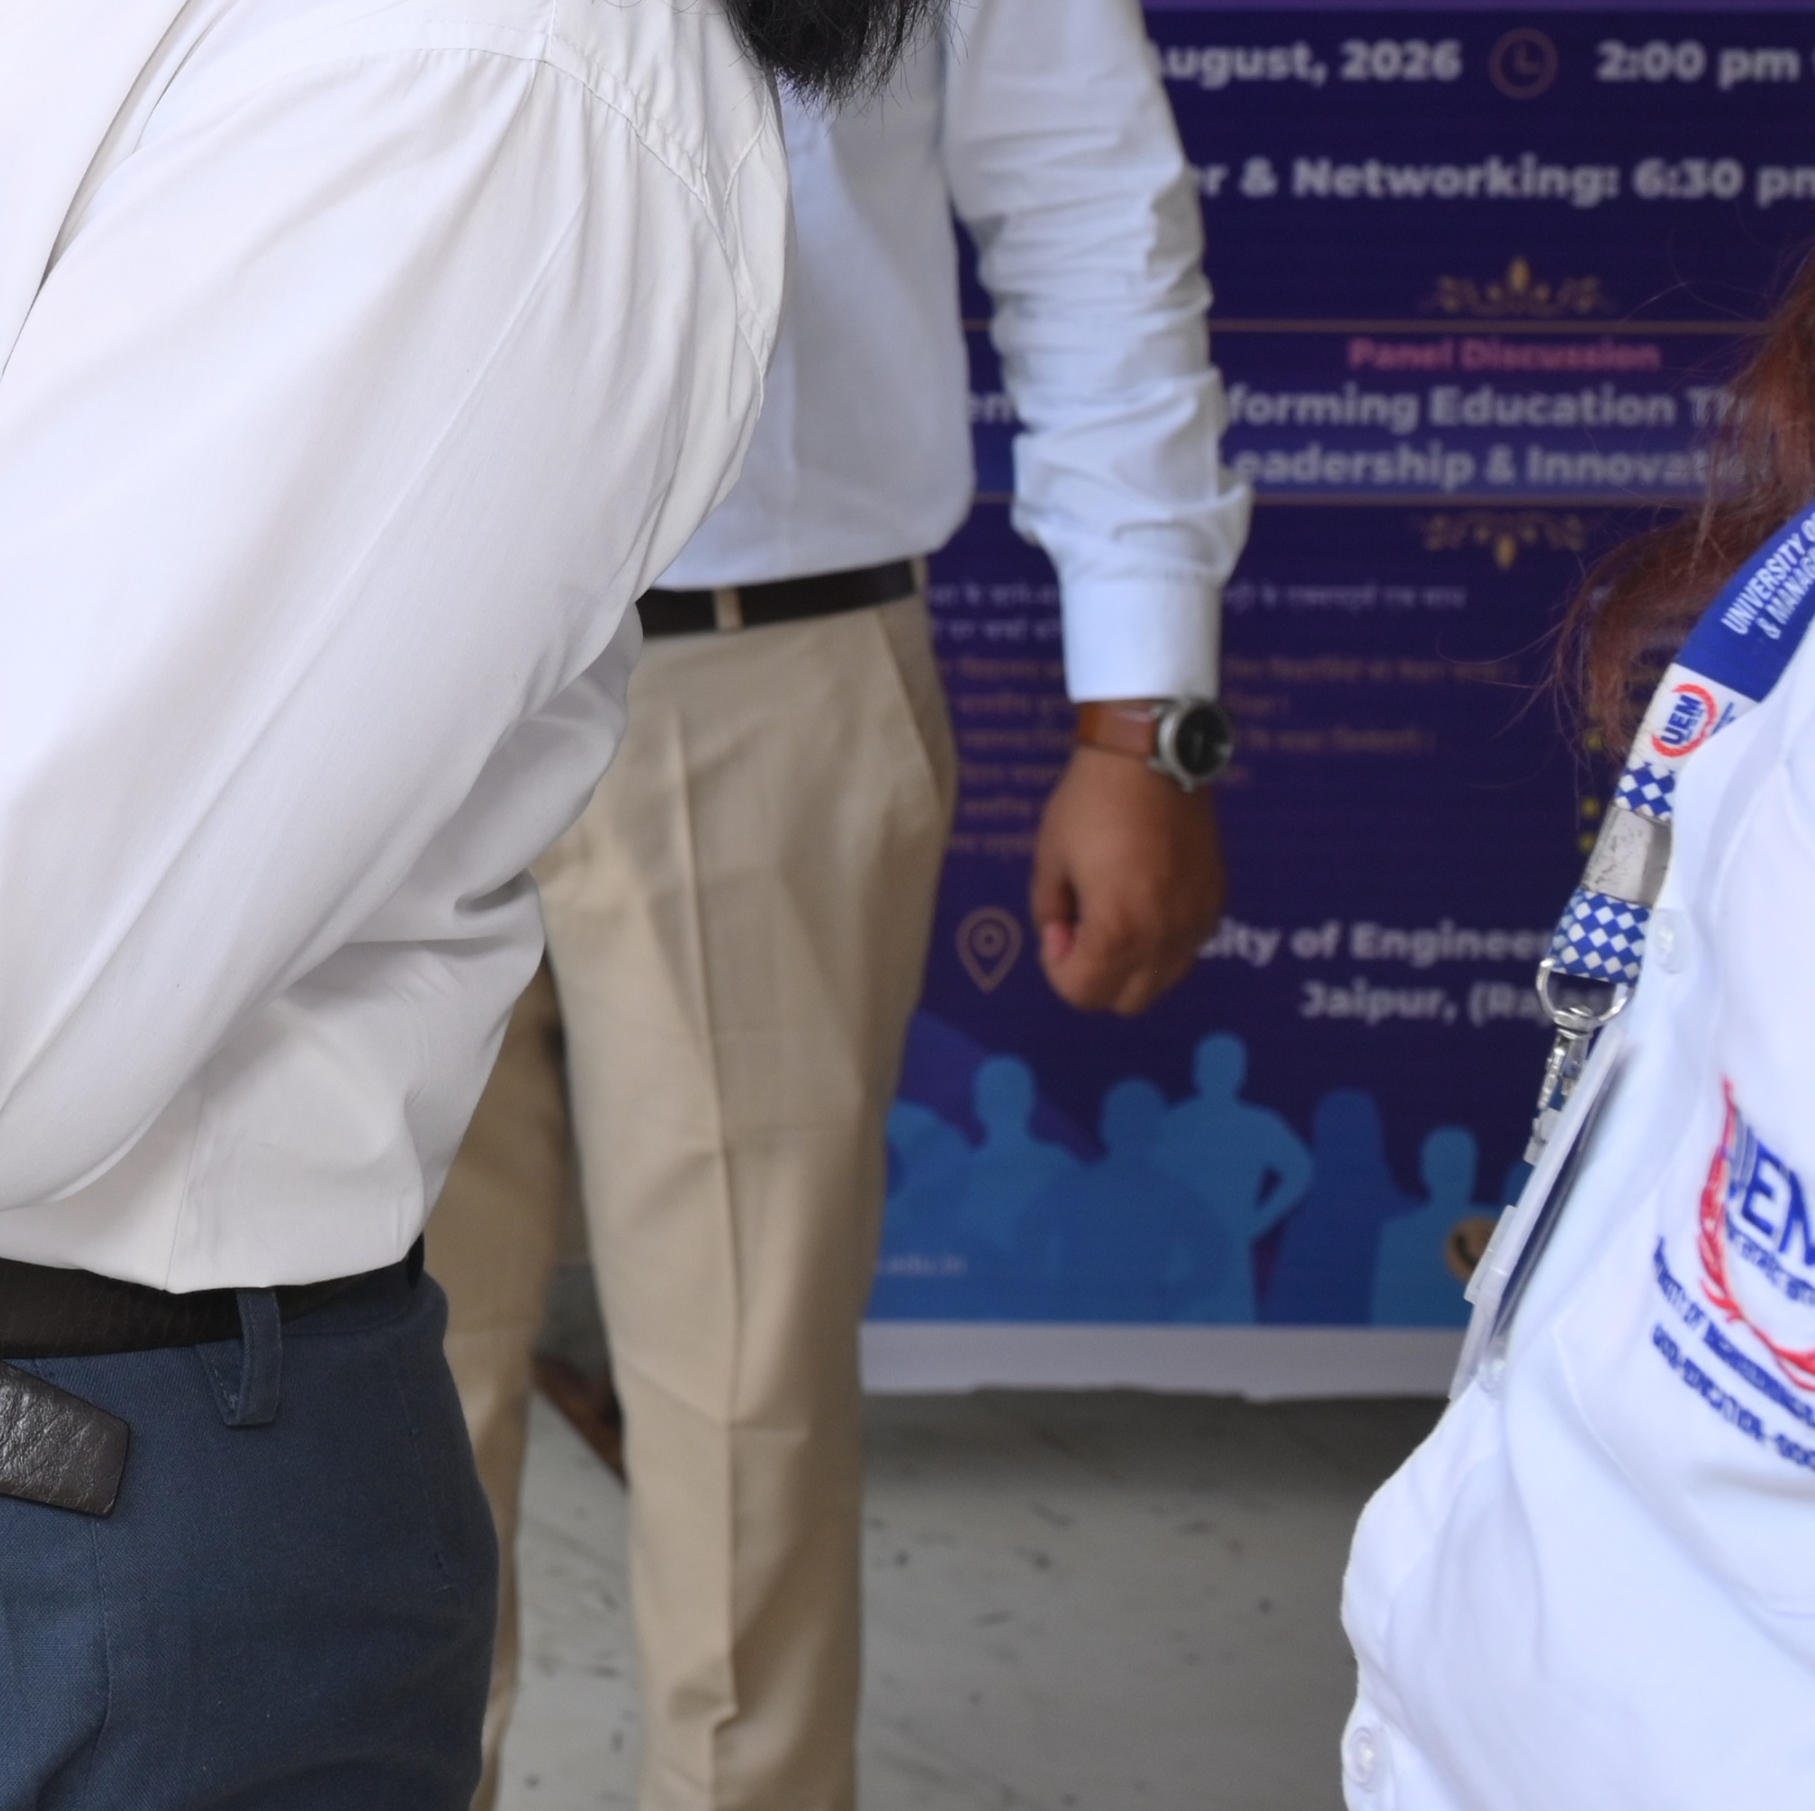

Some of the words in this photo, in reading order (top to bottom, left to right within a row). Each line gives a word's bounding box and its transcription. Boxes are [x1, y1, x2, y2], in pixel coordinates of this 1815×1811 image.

[1165, 38, 1329, 90] ugust,
[1339, 38, 1464, 82] 2026
[1594, 38, 1708, 83] 2:00
[1717, 47, 1802, 91] pm
[1238, 154, 1279, 200] &
[1290, 151, 1621, 210] Networking:
[1631, 156, 1746, 201] 6:30
[1347, 336, 1455, 372] Panel
[1461, 335, 1662, 372] Discussion
[1227, 380, 1420, 436] forming
[1429, 380, 1678, 428] Education
[1232, 438, 1477, 494] eadership
[1483, 441, 1517, 487] &
[1720, 532, 1807, 636] UNIVERSITY
[1660, 693, 1704, 746] UEM
[1289, 917, 1344, 961] of
[1297, 975, 1459, 1029] Jaipur,
